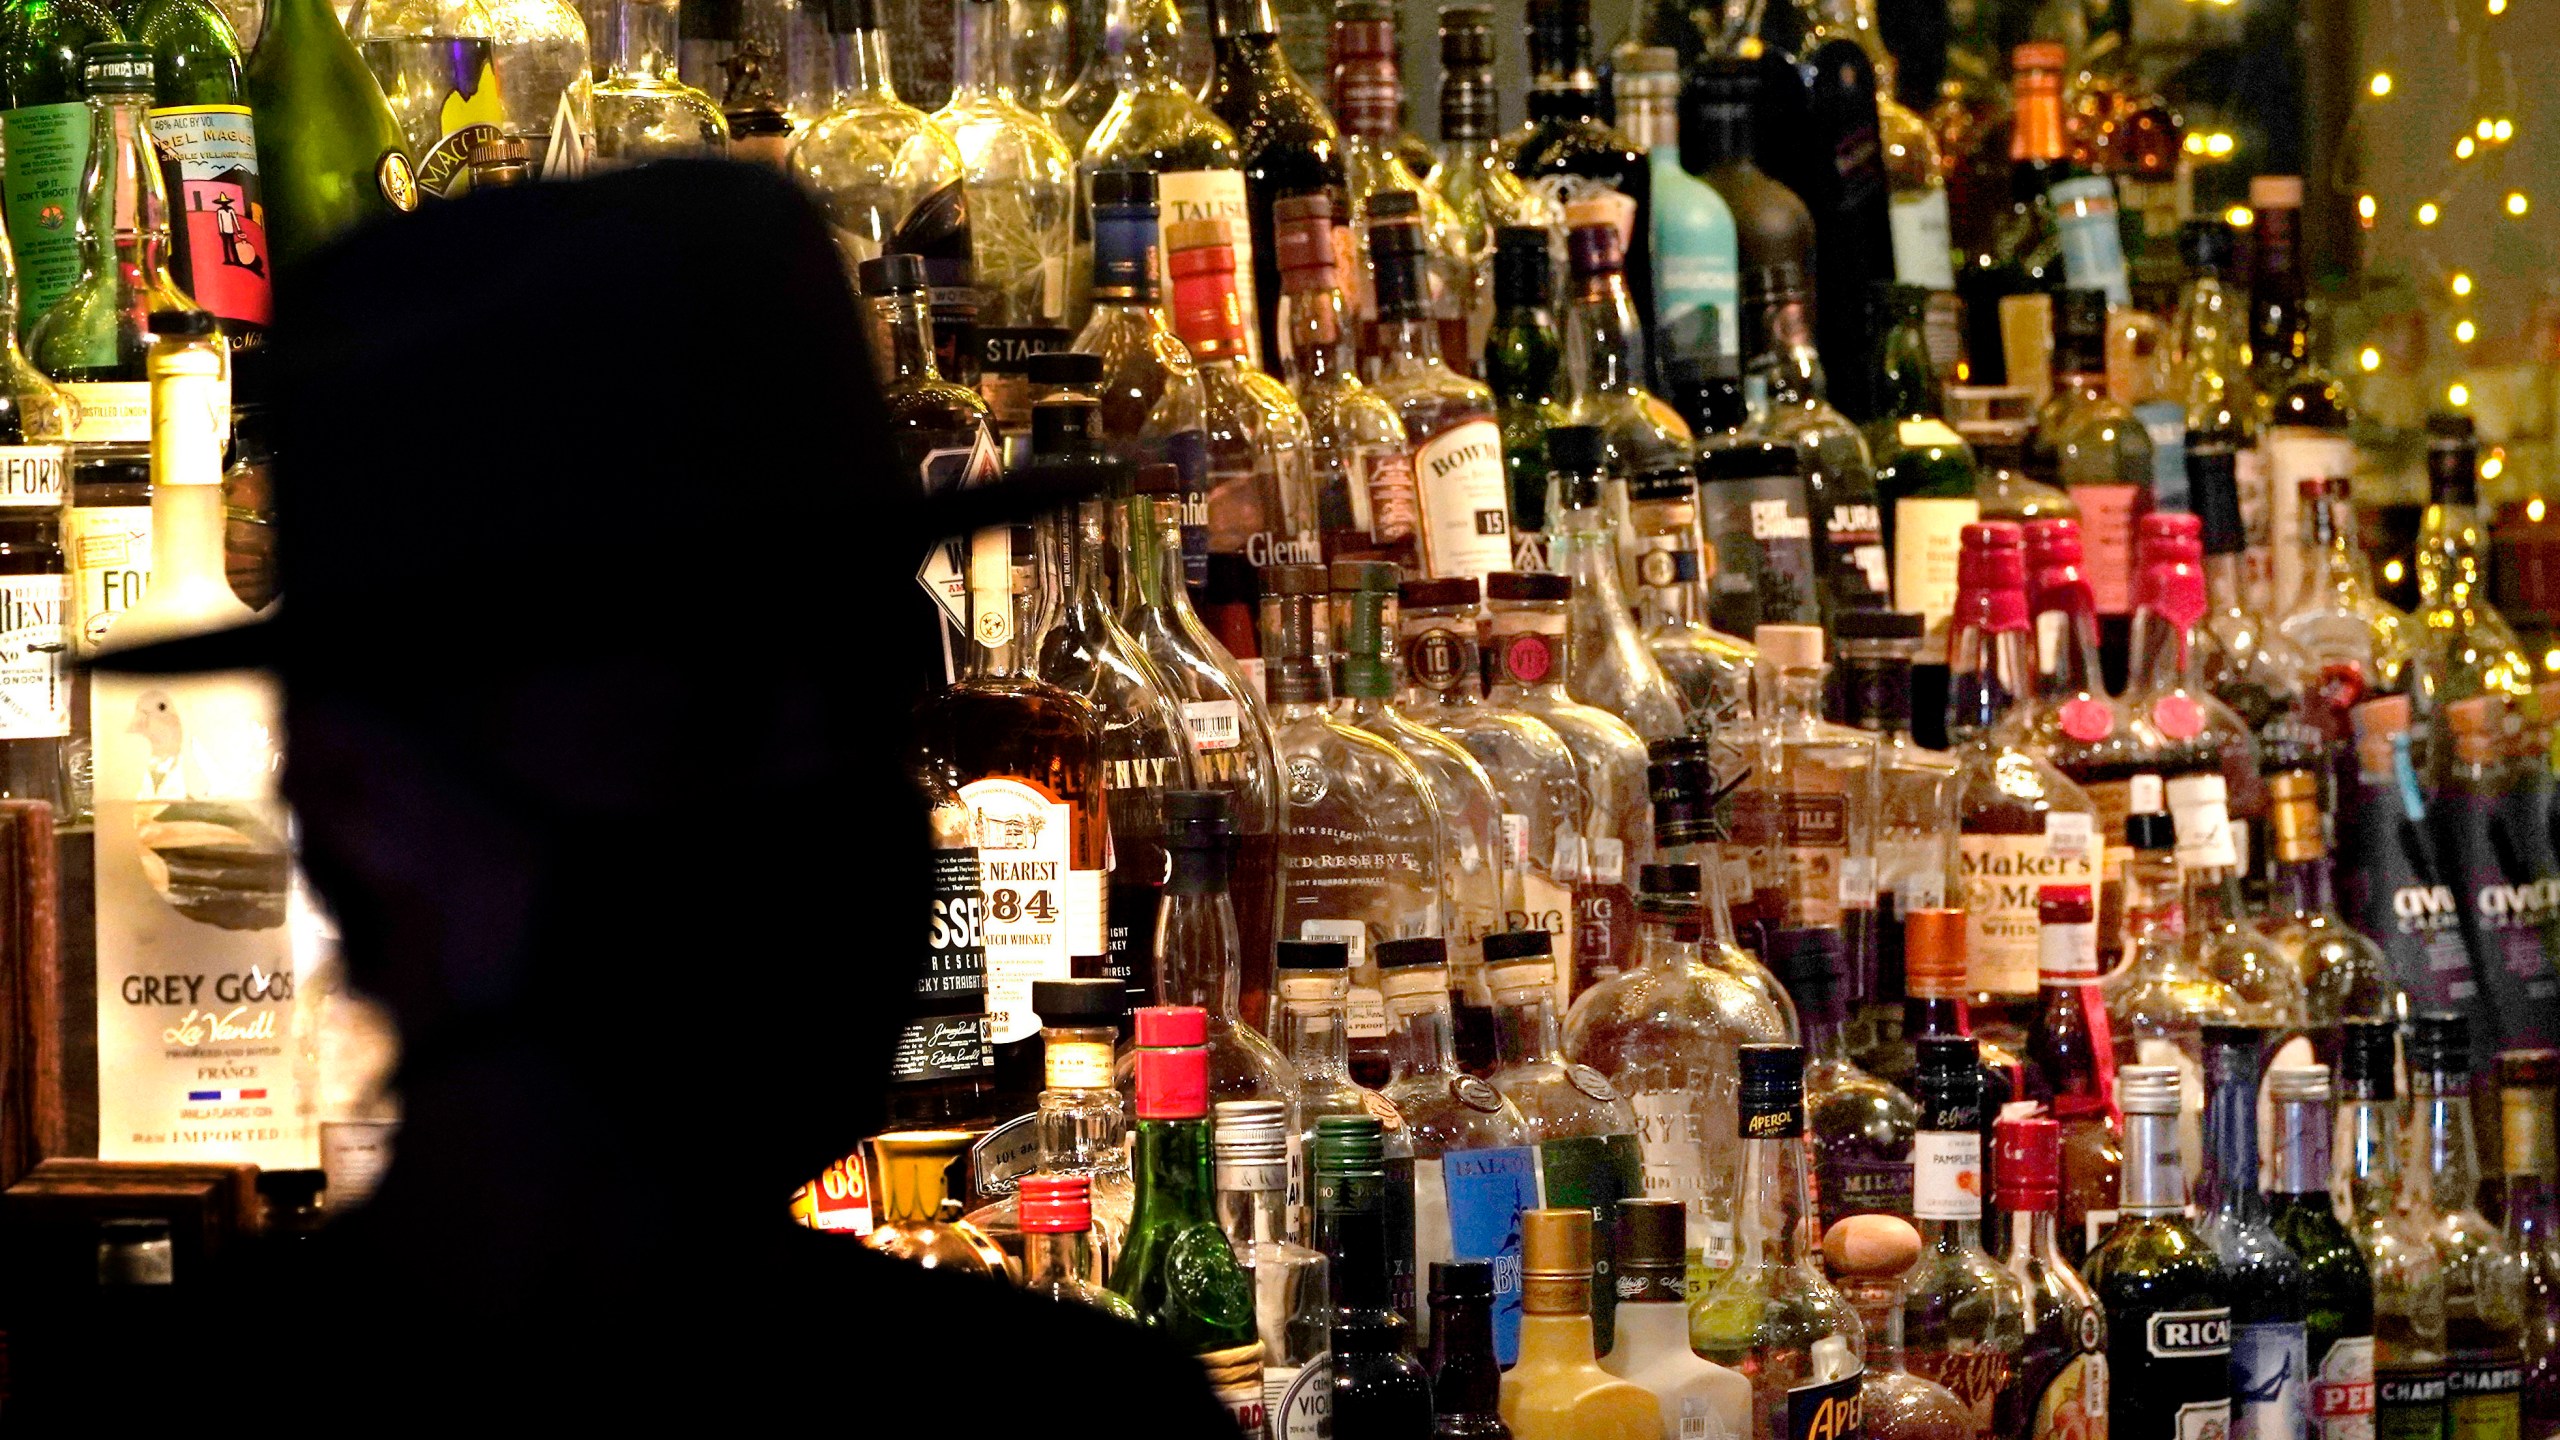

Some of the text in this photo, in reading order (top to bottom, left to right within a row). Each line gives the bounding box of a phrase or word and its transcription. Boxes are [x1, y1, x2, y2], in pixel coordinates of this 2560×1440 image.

[174, 117, 188, 127] ALC
[190, 117, 199, 127] BY
[41, 188, 69, 199] SHOOT
[82, 405, 147, 418] DISTILLED LONDON
[1484, 512, 1502, 534] 15
[1426, 646, 1449, 672] 10
[990, 861, 1059, 882] NEAREST
[1959, 850, 2092, 876] Makers
[1010, 932, 1052, 946] WHISKEY
[121, 973, 204, 1006] GREY
[942, 974, 980, 992] STRAIGHT
[1355, 1022, 1383, 1030] PROOF
[197, 1065, 259, 1081] FRANCE
[1748, 1110, 1793, 1132] APEROL
[172, 1127, 280, 1144] IMPORTED
